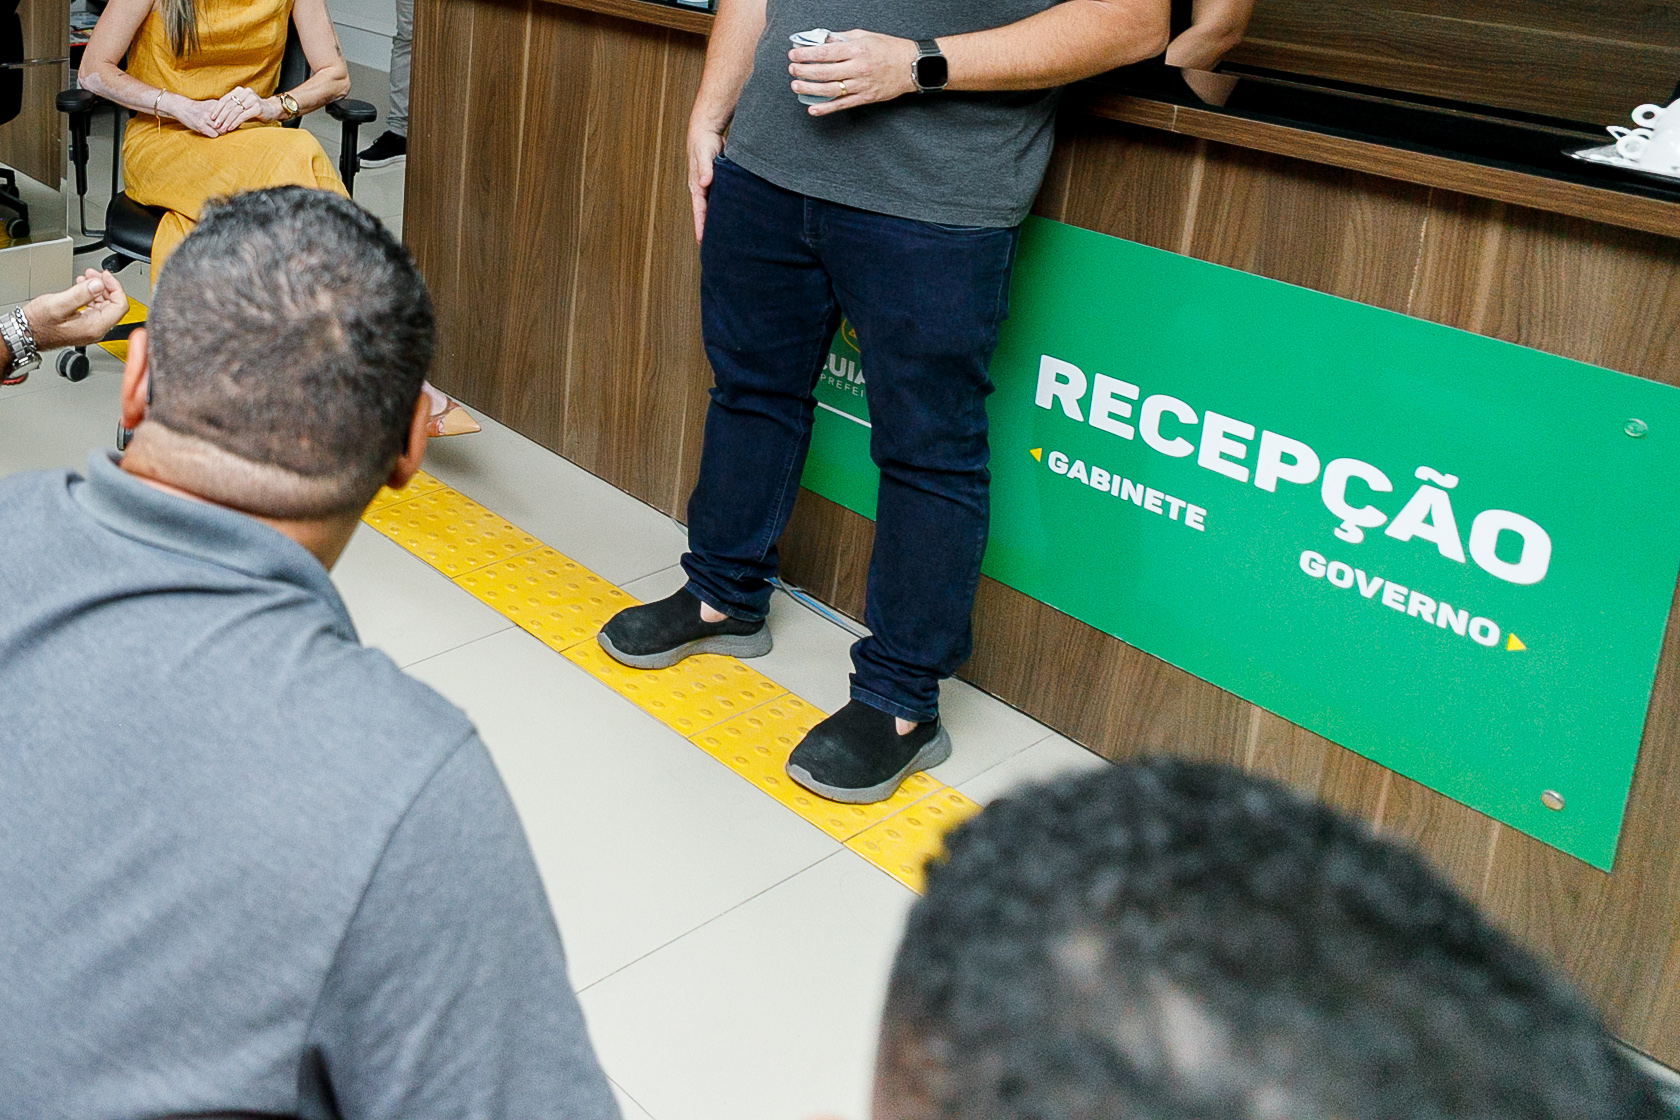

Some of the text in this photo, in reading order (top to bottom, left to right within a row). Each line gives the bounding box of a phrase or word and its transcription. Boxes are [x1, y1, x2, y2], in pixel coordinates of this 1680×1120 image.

[820, 373, 864, 398] PREFEI
[823, 352, 866, 385] UIA
[1034, 354, 1552, 586] RECEPÇÃO
[1047, 450, 1207, 533] GABINETE
[1299, 549, 1501, 648] GOVERNO
